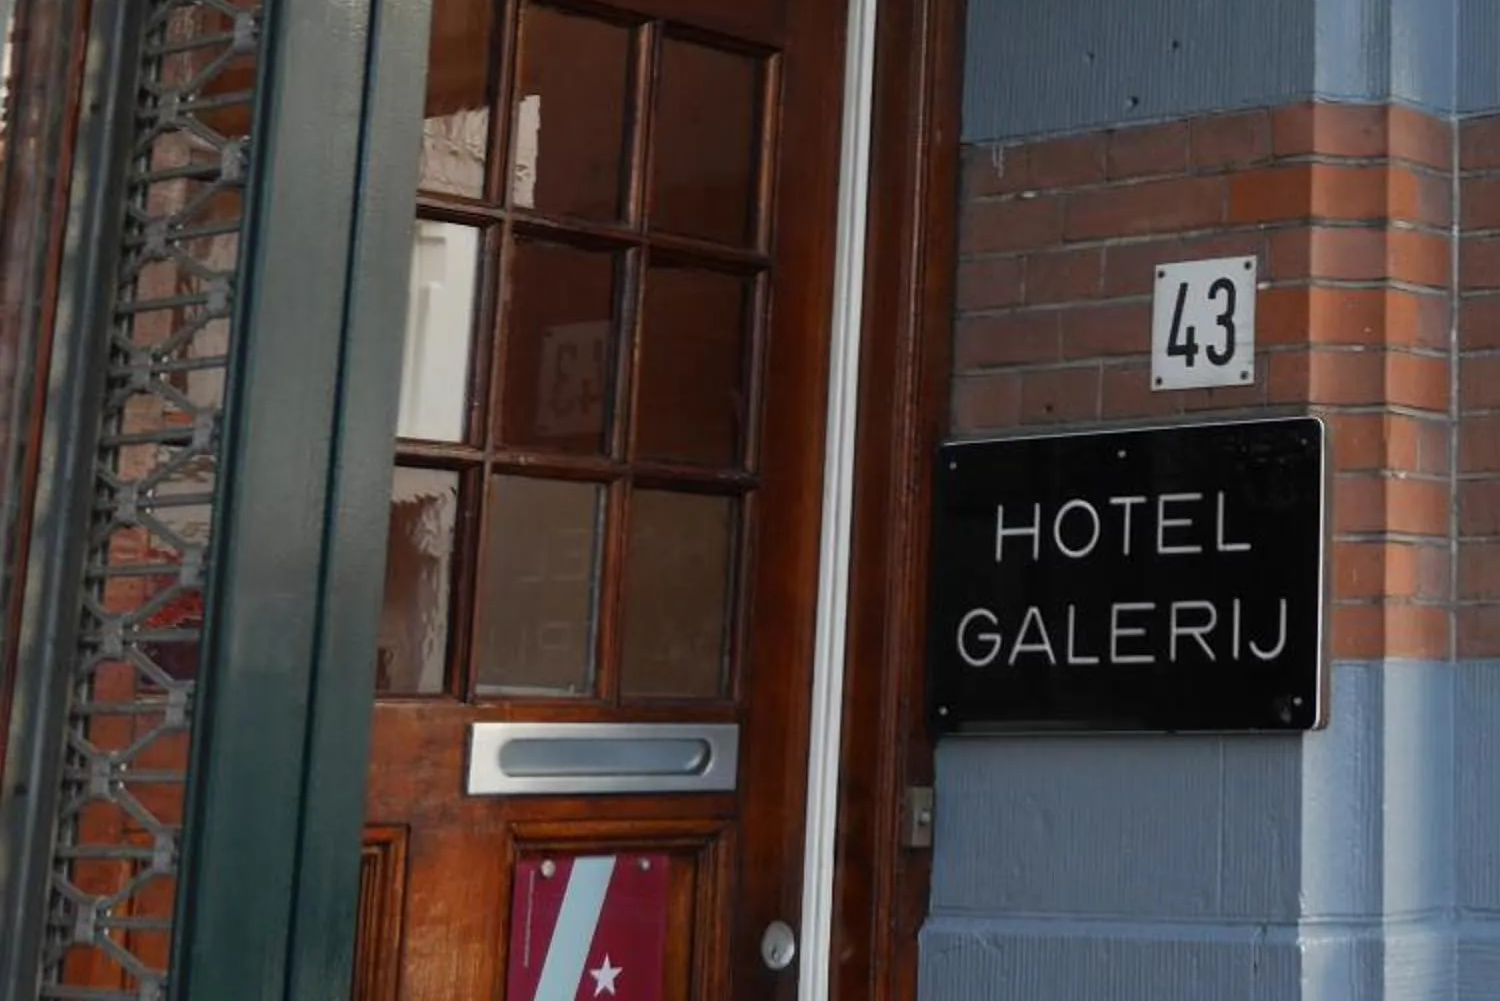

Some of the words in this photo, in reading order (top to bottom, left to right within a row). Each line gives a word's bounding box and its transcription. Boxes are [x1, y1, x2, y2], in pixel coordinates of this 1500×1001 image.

[1165, 276, 1238, 368] 43
[996, 491, 1252, 563] HOTEL
[956, 598, 1288, 666] GALERIJ
